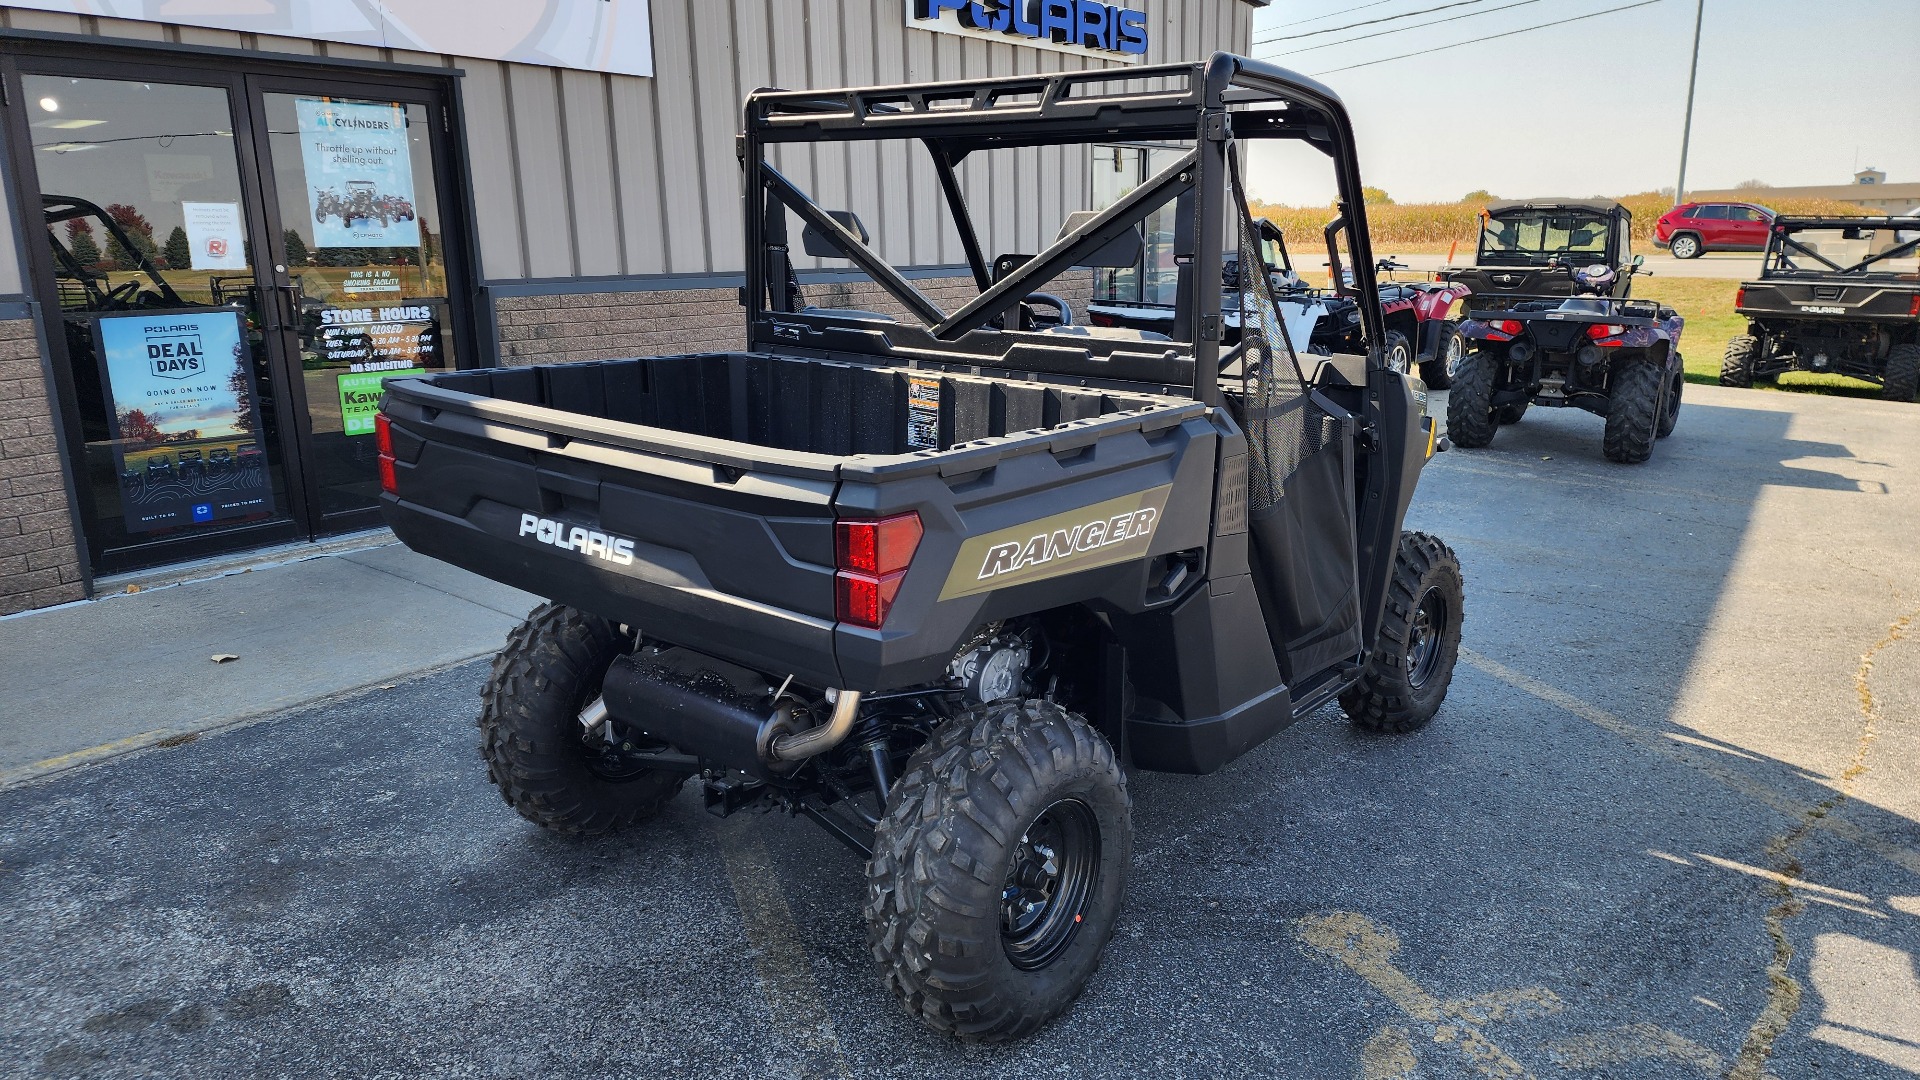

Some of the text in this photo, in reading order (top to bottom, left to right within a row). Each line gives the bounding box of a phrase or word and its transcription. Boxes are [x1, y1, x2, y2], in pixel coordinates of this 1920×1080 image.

[335, 116, 390, 130] CYLINDERS
[315, 143, 397, 155] Throttle up without
[333, 155, 366, 166] shelling
[382, 270, 390, 278] NO
[343, 278, 399, 287] SMOKING FACILITY
[321, 306, 431, 324] STORE HOURS
[1801, 306, 1846, 314] POLARIS
[144, 324, 199, 333] POLARIS
[325, 328, 341, 336] SUN
[346, 327, 364, 335] MON
[370, 324, 404, 335] CLOSED
[325, 340, 343, 348] TUES
[147, 342, 203, 359] DEAL
[327, 349, 367, 360] SATURDAY
[157, 358, 199, 372] DAYS
[350, 360, 413, 373] NO SOLICITING
[147, 388, 176, 396] GOING
[519, 513, 635, 566] POLARIS
[977, 507, 1157, 580] RANGER
